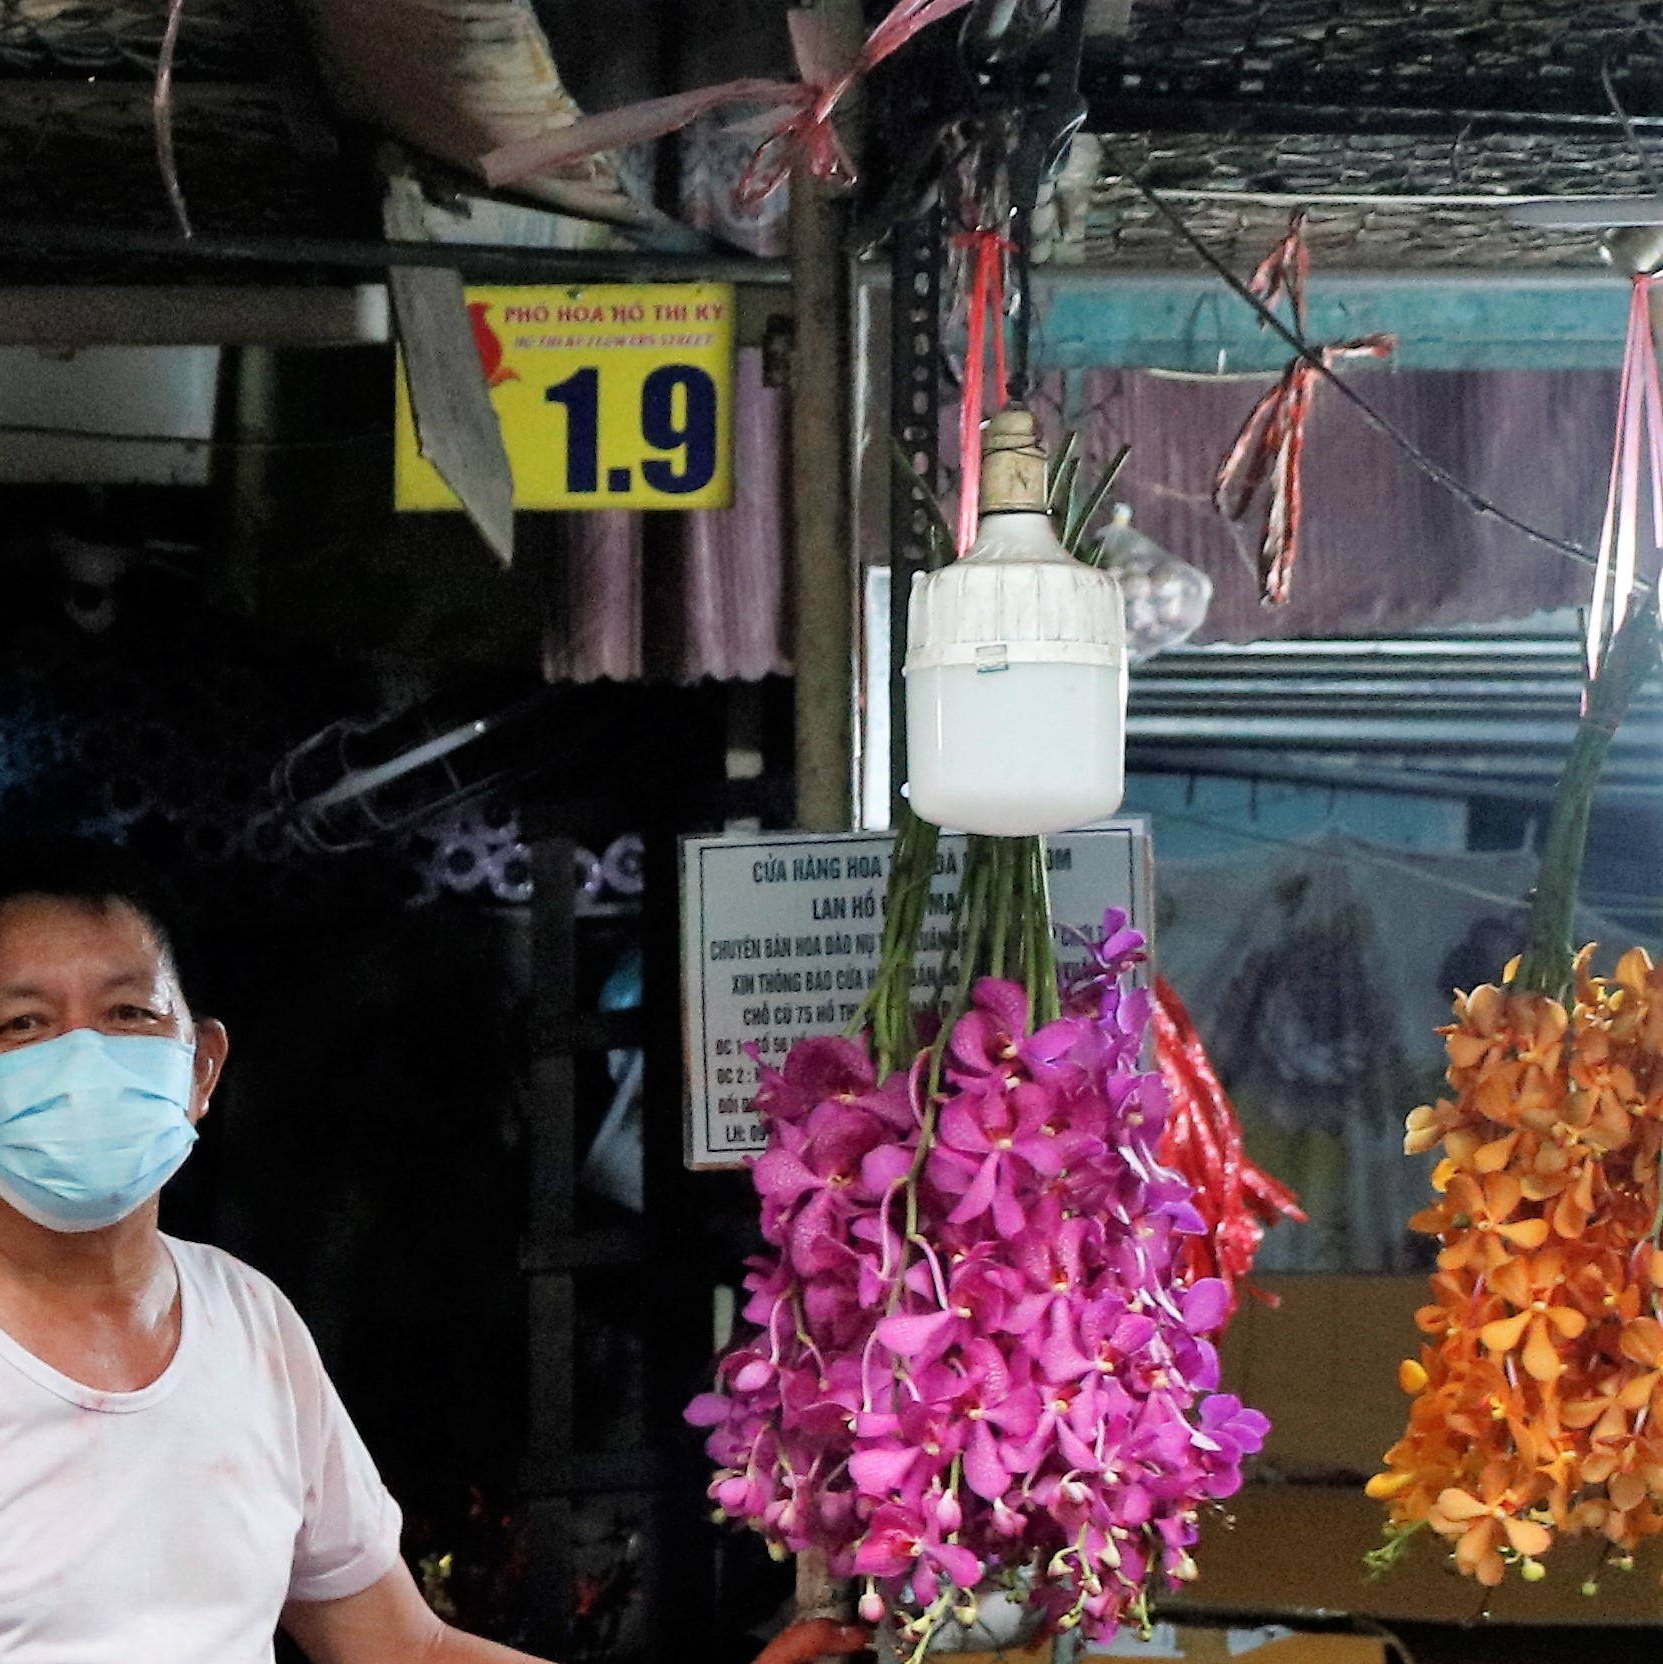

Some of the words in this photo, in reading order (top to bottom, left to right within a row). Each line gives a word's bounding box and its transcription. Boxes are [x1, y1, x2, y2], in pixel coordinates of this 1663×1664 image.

[557, 304, 604, 323] HOA
[545, 364, 717, 494] 1.9
[846, 855, 882, 879] HOA
